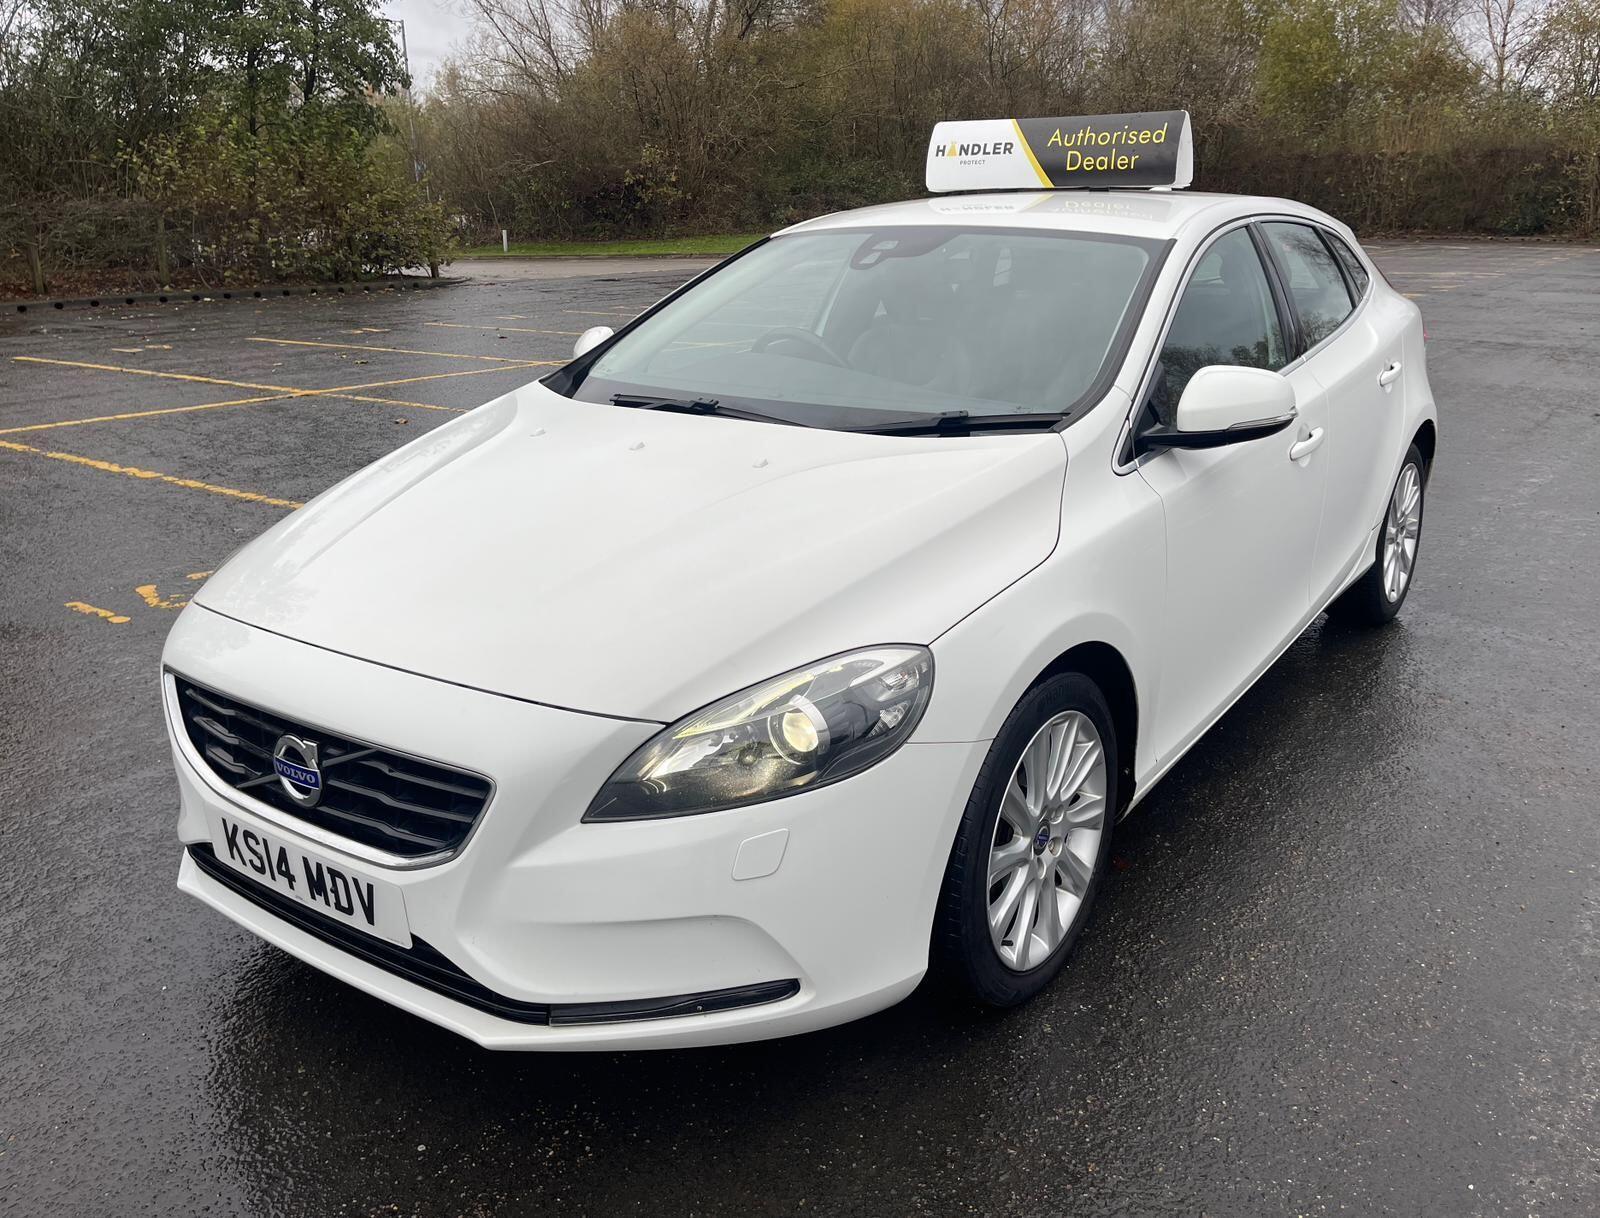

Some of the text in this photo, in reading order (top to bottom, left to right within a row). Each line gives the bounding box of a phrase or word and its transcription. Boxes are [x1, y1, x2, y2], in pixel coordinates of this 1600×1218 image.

[1047, 122, 1168, 147] Authorised
[959, 159, 986, 167] PROTECT
[1065, 149, 1140, 171] Dealer
[276, 761, 316, 784] VOLVO
[221, 817, 375, 927] KS14 MDV
